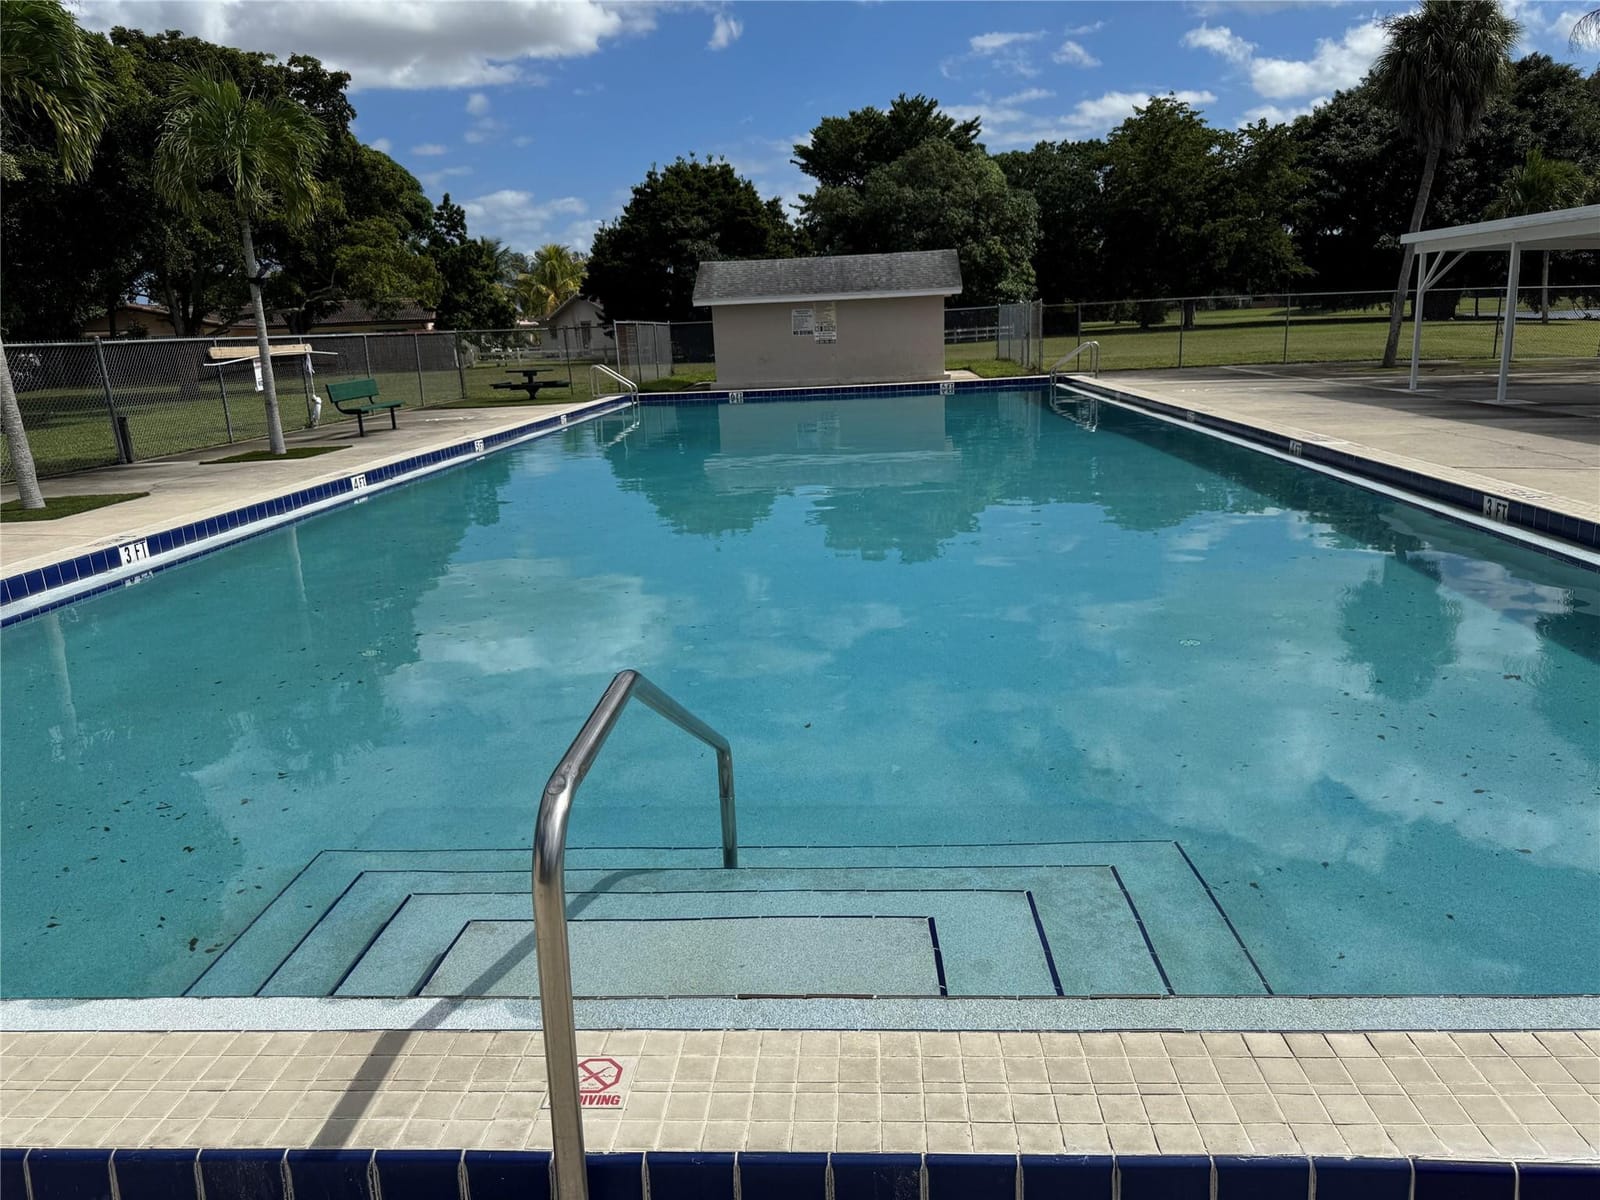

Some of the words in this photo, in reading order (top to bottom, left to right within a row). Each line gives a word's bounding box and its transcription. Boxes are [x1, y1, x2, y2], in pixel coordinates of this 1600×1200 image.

[354, 478, 359, 488] 4
[359, 476, 366, 487] FT
[1486, 498, 1492, 515] 3
[1496, 503, 1507, 520] FT
[124, 547, 132, 563] 3
[134, 542, 147, 560] FT
[580, 1095, 621, 1105] IVING
